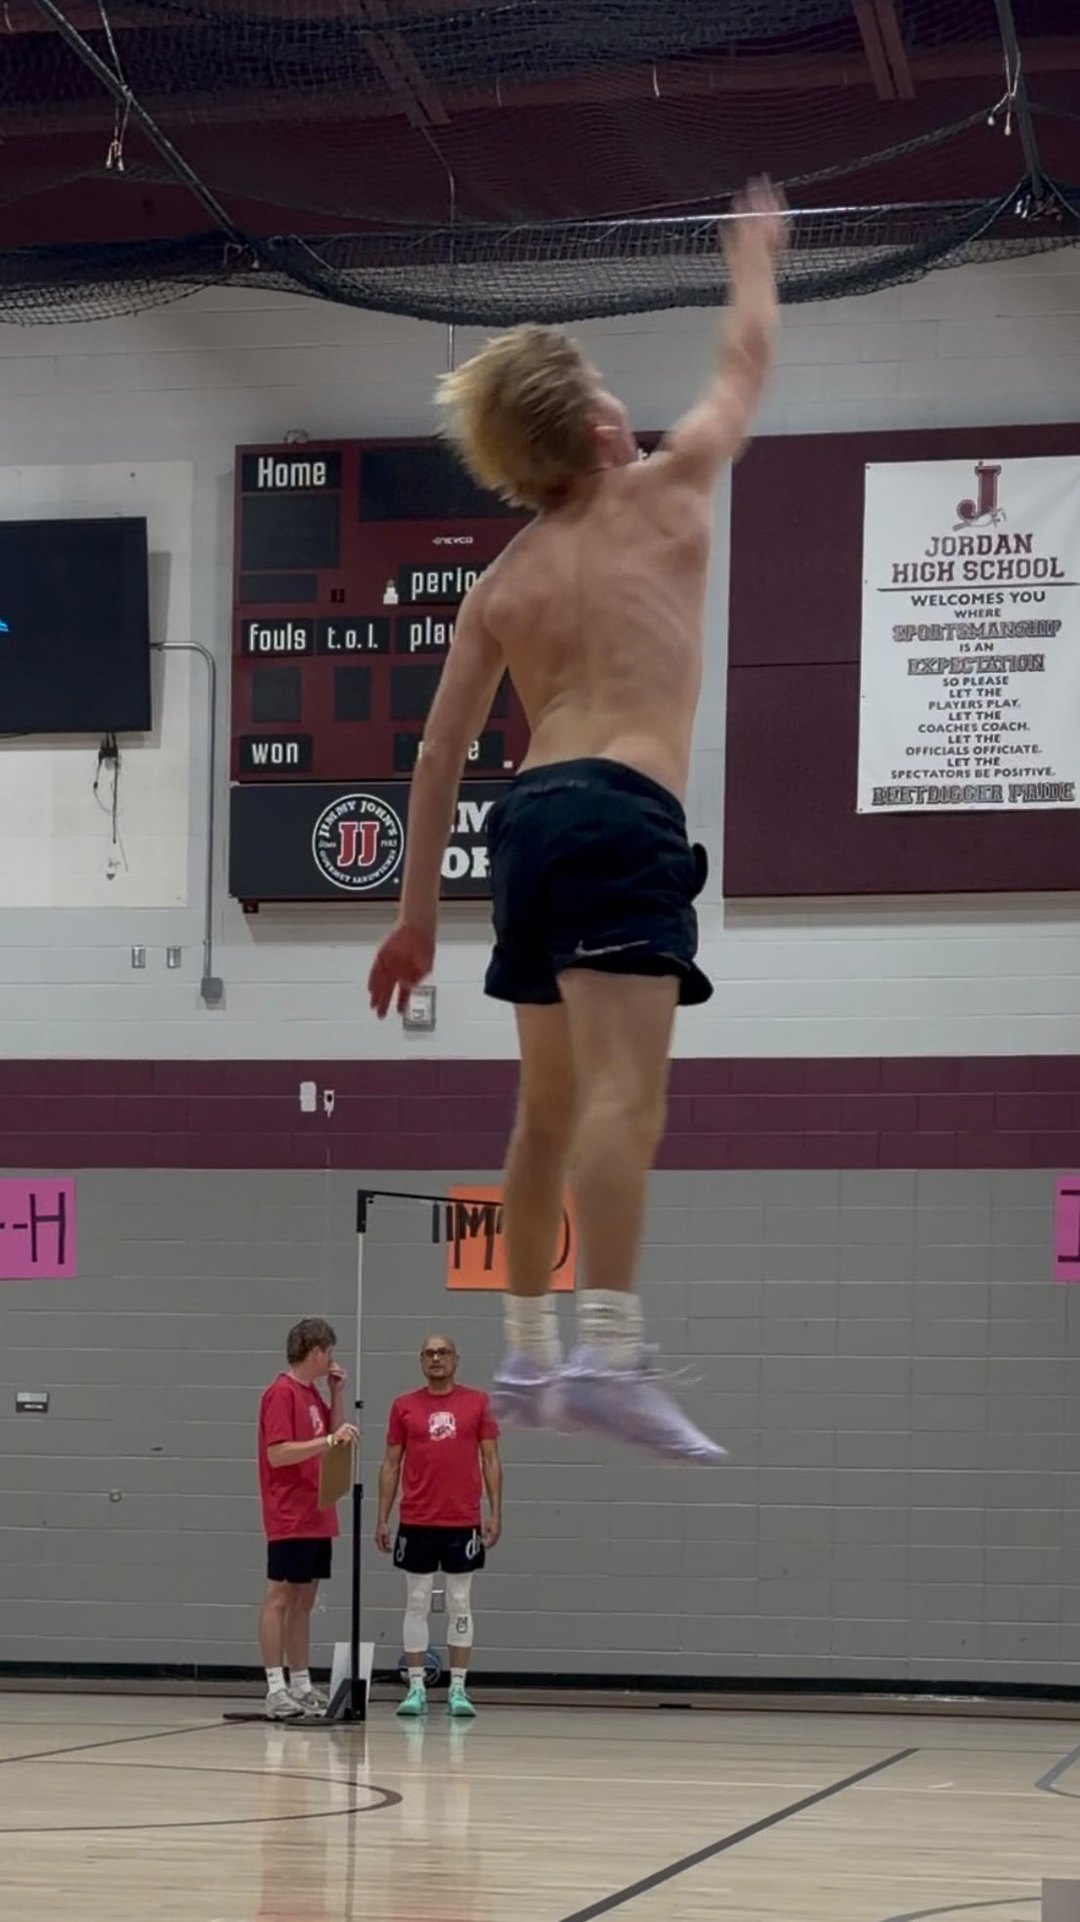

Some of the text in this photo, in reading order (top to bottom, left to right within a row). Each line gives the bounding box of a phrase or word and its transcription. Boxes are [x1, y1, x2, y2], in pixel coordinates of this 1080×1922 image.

[258, 457, 326, 488] Home
[925, 533, 1033, 557] JORDAN
[892, 557, 1065, 583] HIGH SCHOOL
[412, 567, 478, 601] perio
[911, 591, 1046, 606] WELCOMES YOU
[954, 608, 1001, 618] WHERE
[249, 622, 307, 651] fouls
[892, 619, 1062, 642] SPORTSMANSHIP
[960, 642, 994, 652] IS AN
[908, 654, 1045, 675] EXPECTATION
[943, 676, 1009, 687] SO PLEASE
[950, 688, 1002, 698] LET THE
[928, 699, 1021, 710] PLAYERS PLAY.
[949, 711, 1001, 721] LET THE
[918, 722, 1030, 733] COACHES COACH.
[948, 734, 1001, 744] LET THE
[252, 742, 298, 764] won
[905, 745, 1042, 756] OFFICIALS OFFICIATE.
[947, 757, 1000, 767] LET THE
[891, 767, 1055, 779] SPECTATORS BE POSITIVE.
[872, 782, 1075, 806] BEETDIGGER PRIDE
[318, 800, 356, 838] JIMMY
[337, 821, 380, 866] JJ
